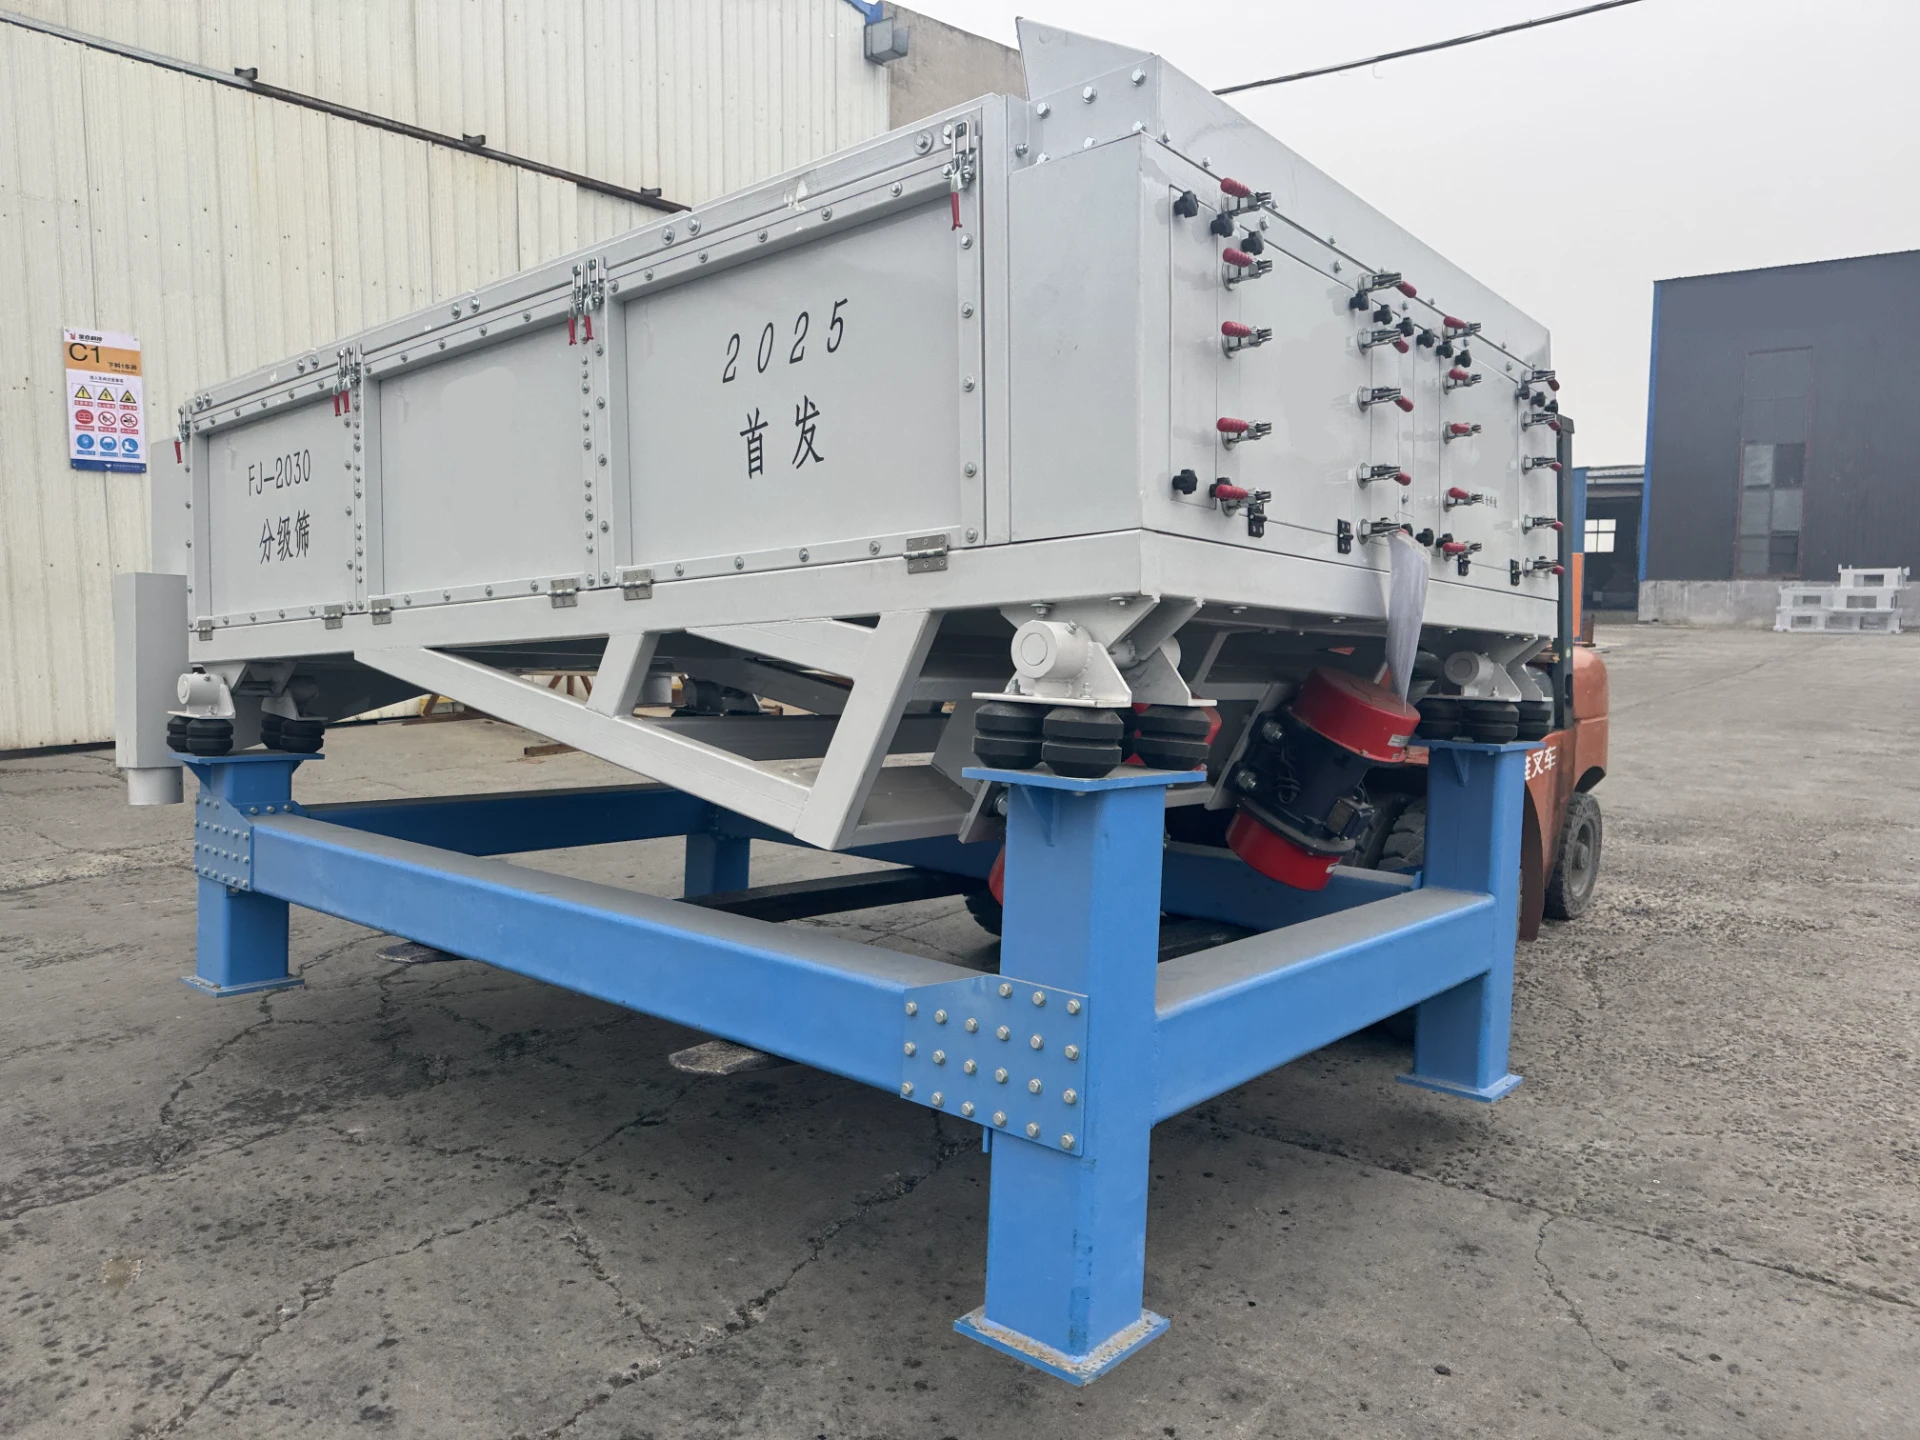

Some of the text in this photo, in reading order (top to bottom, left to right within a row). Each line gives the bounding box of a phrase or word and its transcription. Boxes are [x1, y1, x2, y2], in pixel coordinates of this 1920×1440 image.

[68, 342, 100, 364] C1
[722, 297, 848, 384] 2025
[739, 394, 825, 479] 首发
[248, 448, 311, 497] FJ-2030
[258, 508, 310, 564] 分级筛
